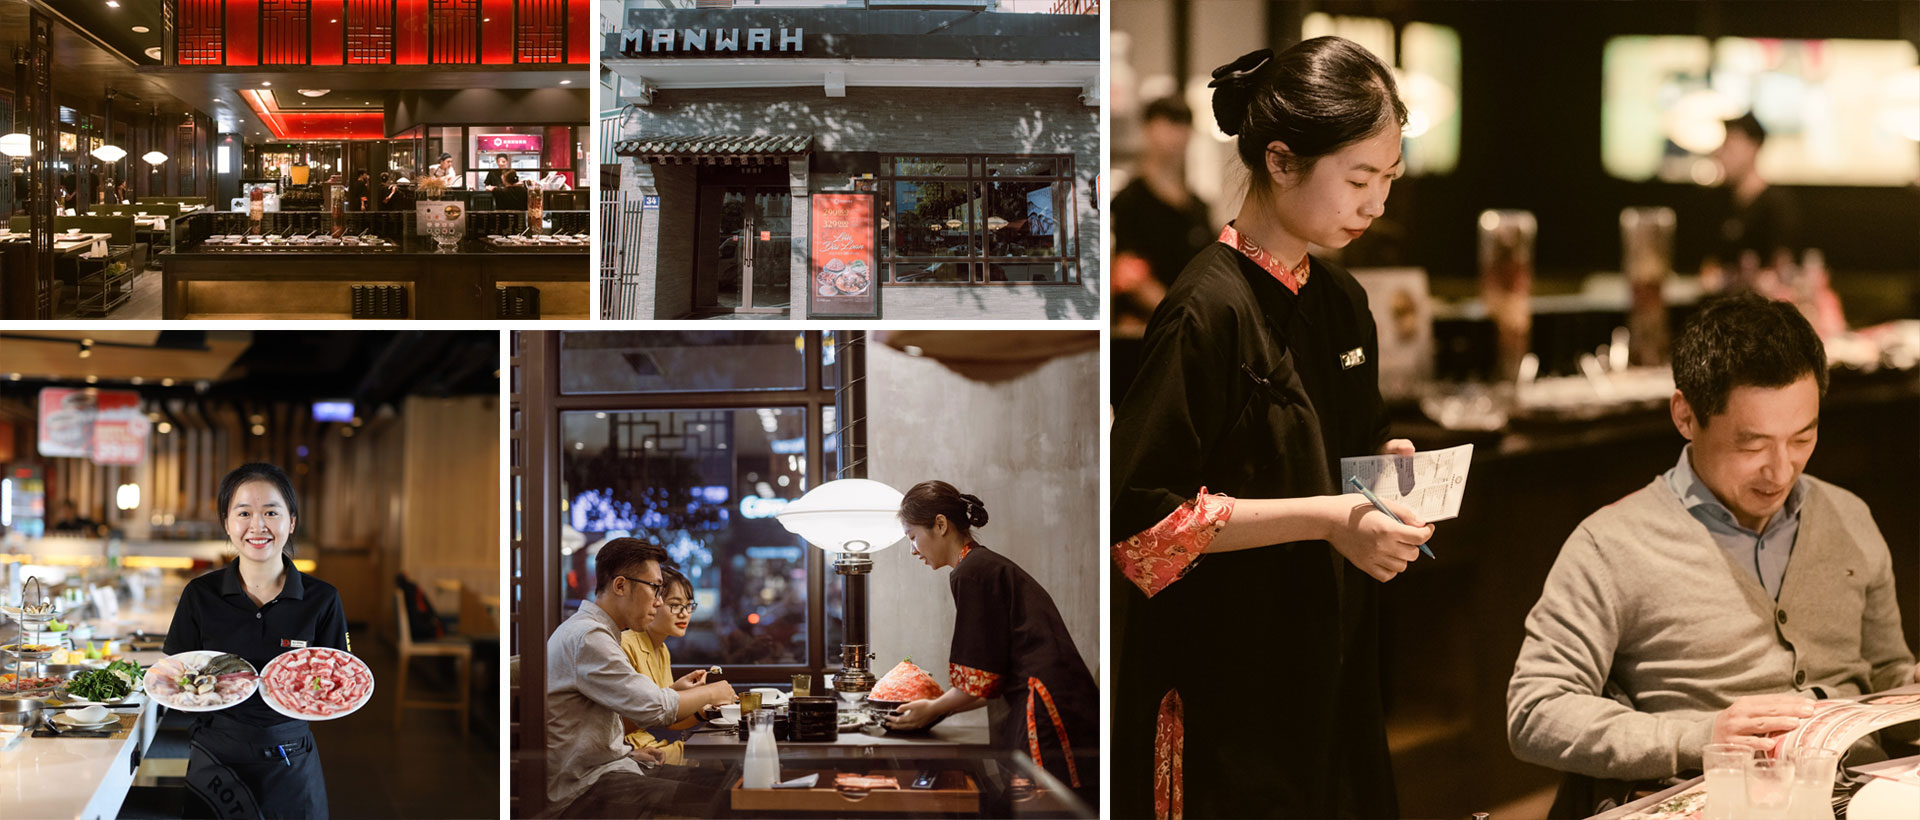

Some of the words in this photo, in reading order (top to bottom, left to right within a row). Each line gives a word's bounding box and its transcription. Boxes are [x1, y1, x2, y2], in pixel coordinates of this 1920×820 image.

[619, 28, 803, 52] MANWAH
[646, 196, 657, 205] 34
[208, 775, 244, 815] ROT
